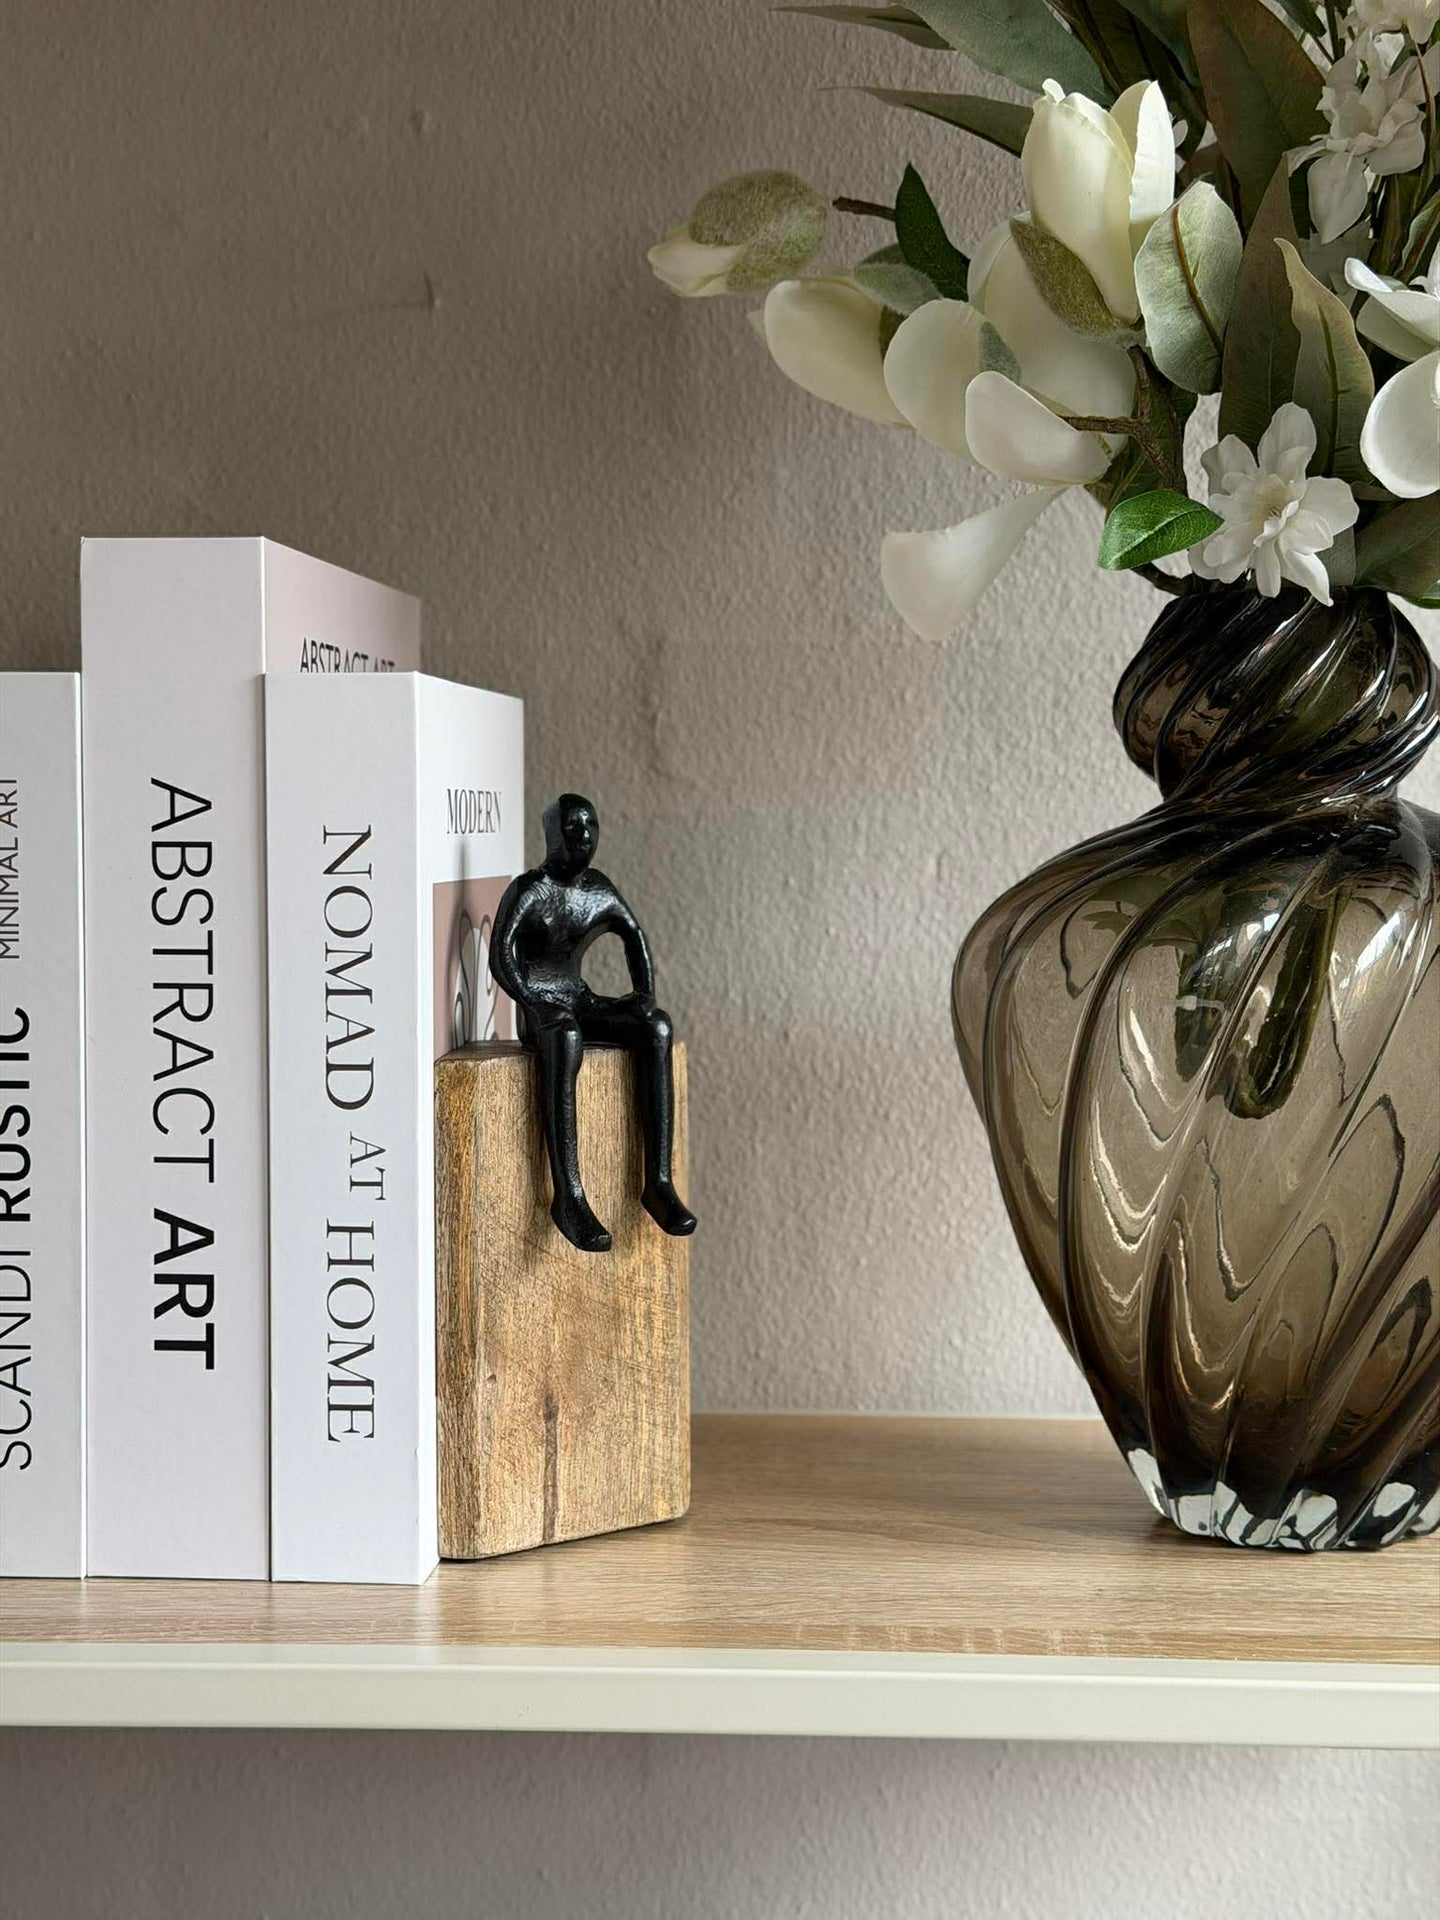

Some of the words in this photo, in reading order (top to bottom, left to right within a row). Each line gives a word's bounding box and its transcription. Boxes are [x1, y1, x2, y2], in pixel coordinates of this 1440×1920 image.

[0, 836, 19, 959] MINIMAL
[447, 788, 502, 835] MODERN
[151, 777, 215, 1184] ABSTRACT
[322, 824, 376, 1111] NOMAD
[349, 1131, 387, 1201] AT
[0, 1250, 32, 1471] SCANDI
[153, 1207, 215, 1371] ART
[326, 1218, 376, 1443] HOME
